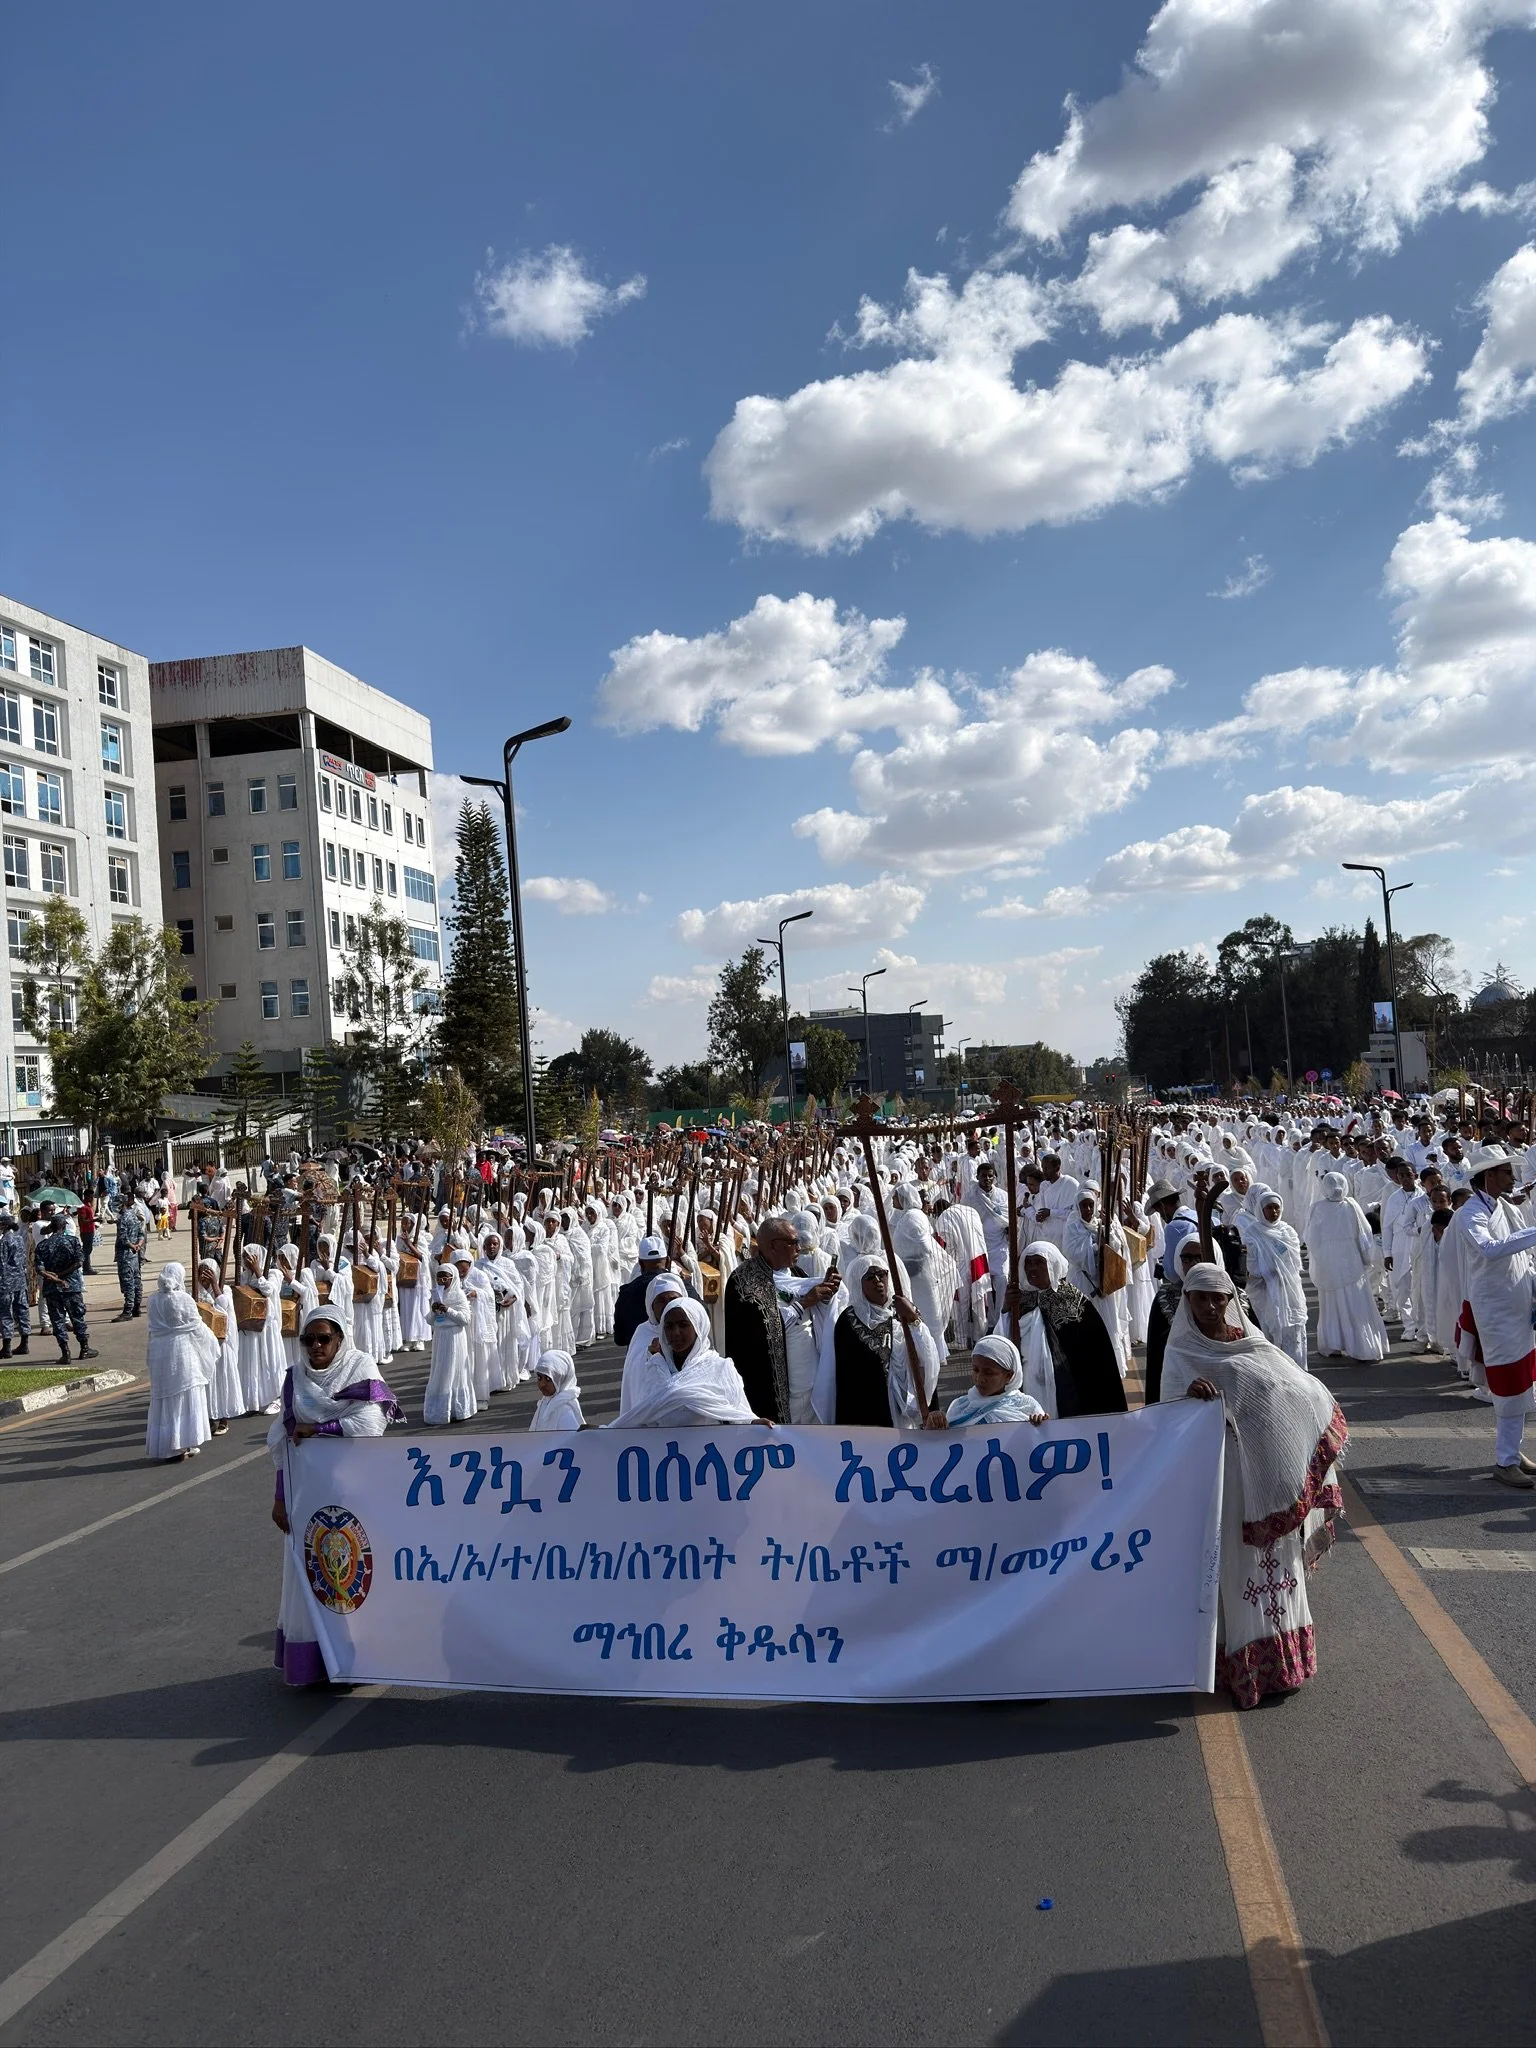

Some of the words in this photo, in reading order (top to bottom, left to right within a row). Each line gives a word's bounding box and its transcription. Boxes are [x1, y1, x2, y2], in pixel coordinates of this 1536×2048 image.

[406, 1446, 582, 1514] እንኳን
[617, 1441, 796, 1502] በሰላም
[835, 1432, 1113, 1503] አደረሰዎ!
[760, 1536, 911, 1585] ት/ቤቶች
[935, 1528, 1152, 1581] ማ/መምሪያ
[573, 1622, 693, 1660] ማኅበረ
[716, 1616, 845, 1663] ቅዱሳን
